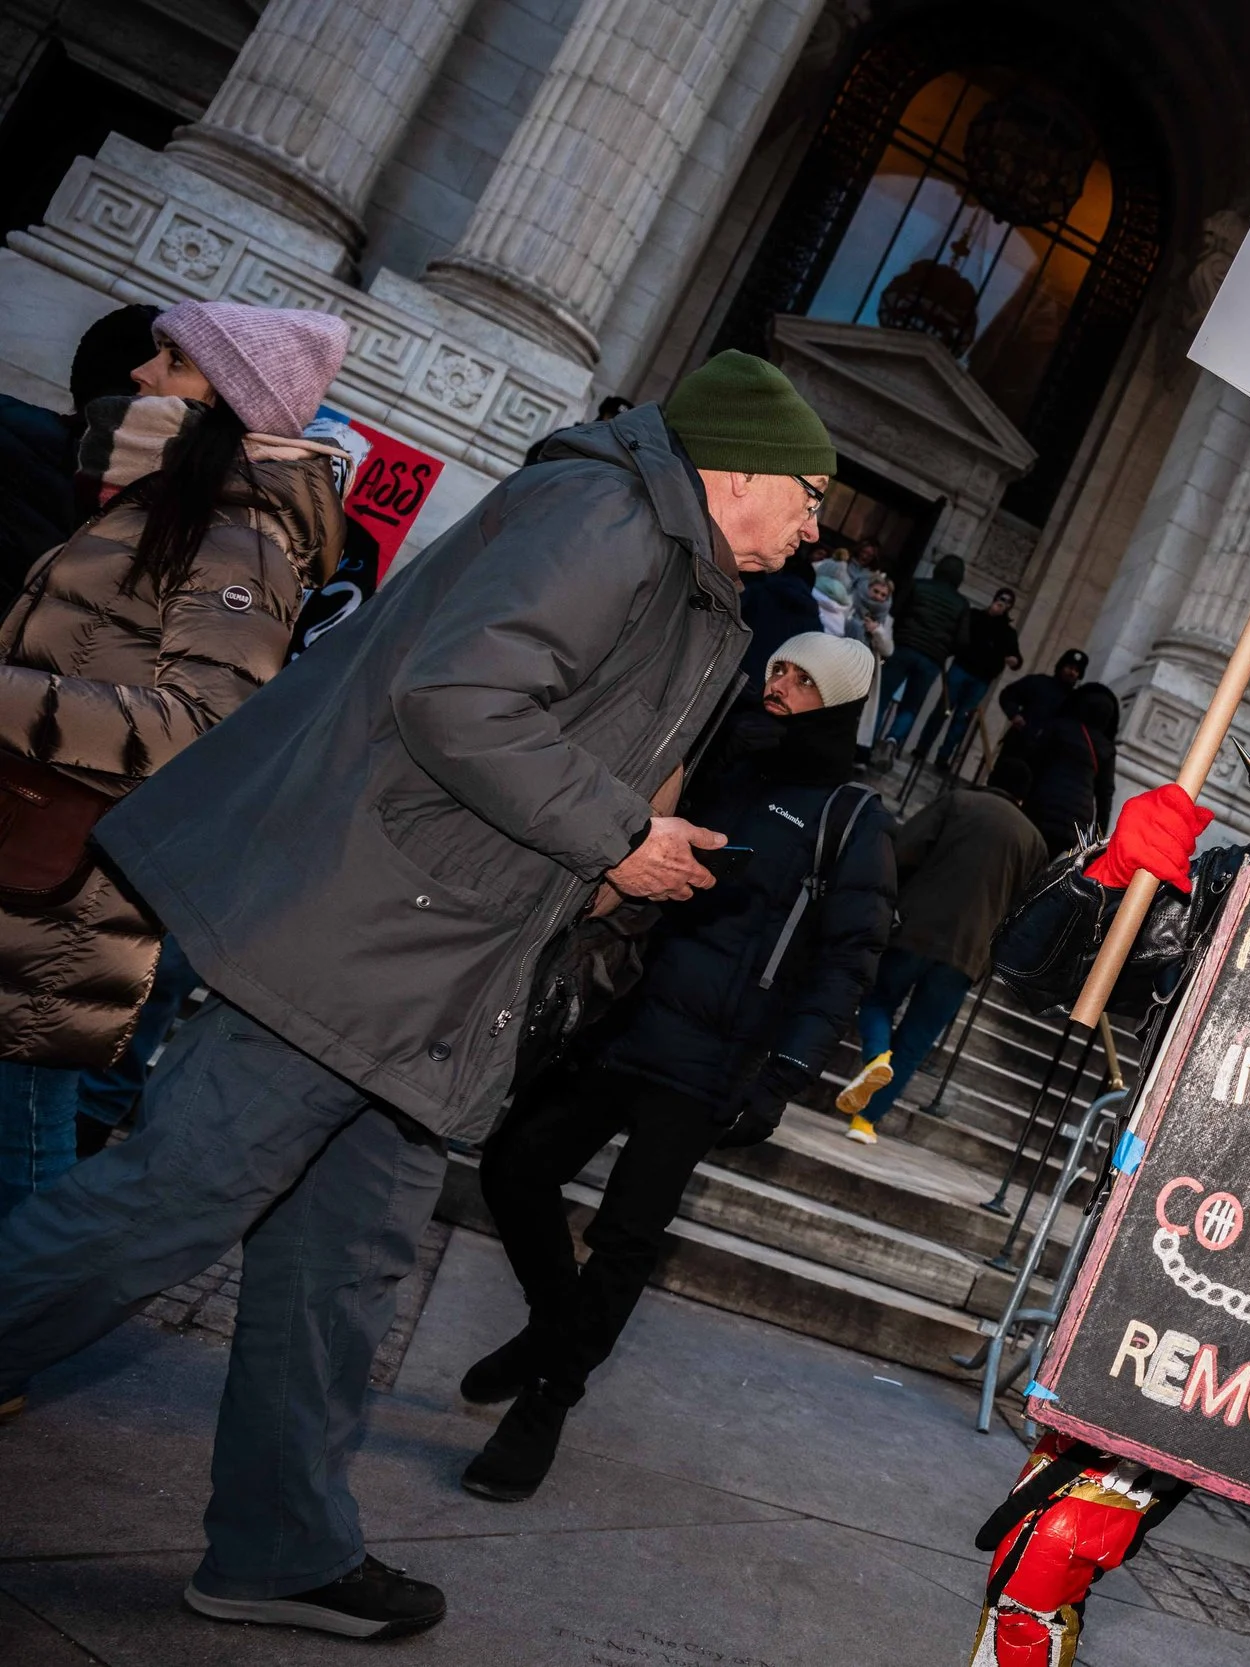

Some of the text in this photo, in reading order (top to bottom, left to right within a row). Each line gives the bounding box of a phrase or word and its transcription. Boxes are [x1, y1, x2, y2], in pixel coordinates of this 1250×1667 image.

[354, 457, 431, 516] ASS
[226, 591, 249, 603] COLMAR
[775, 806, 805, 829] Columbia
